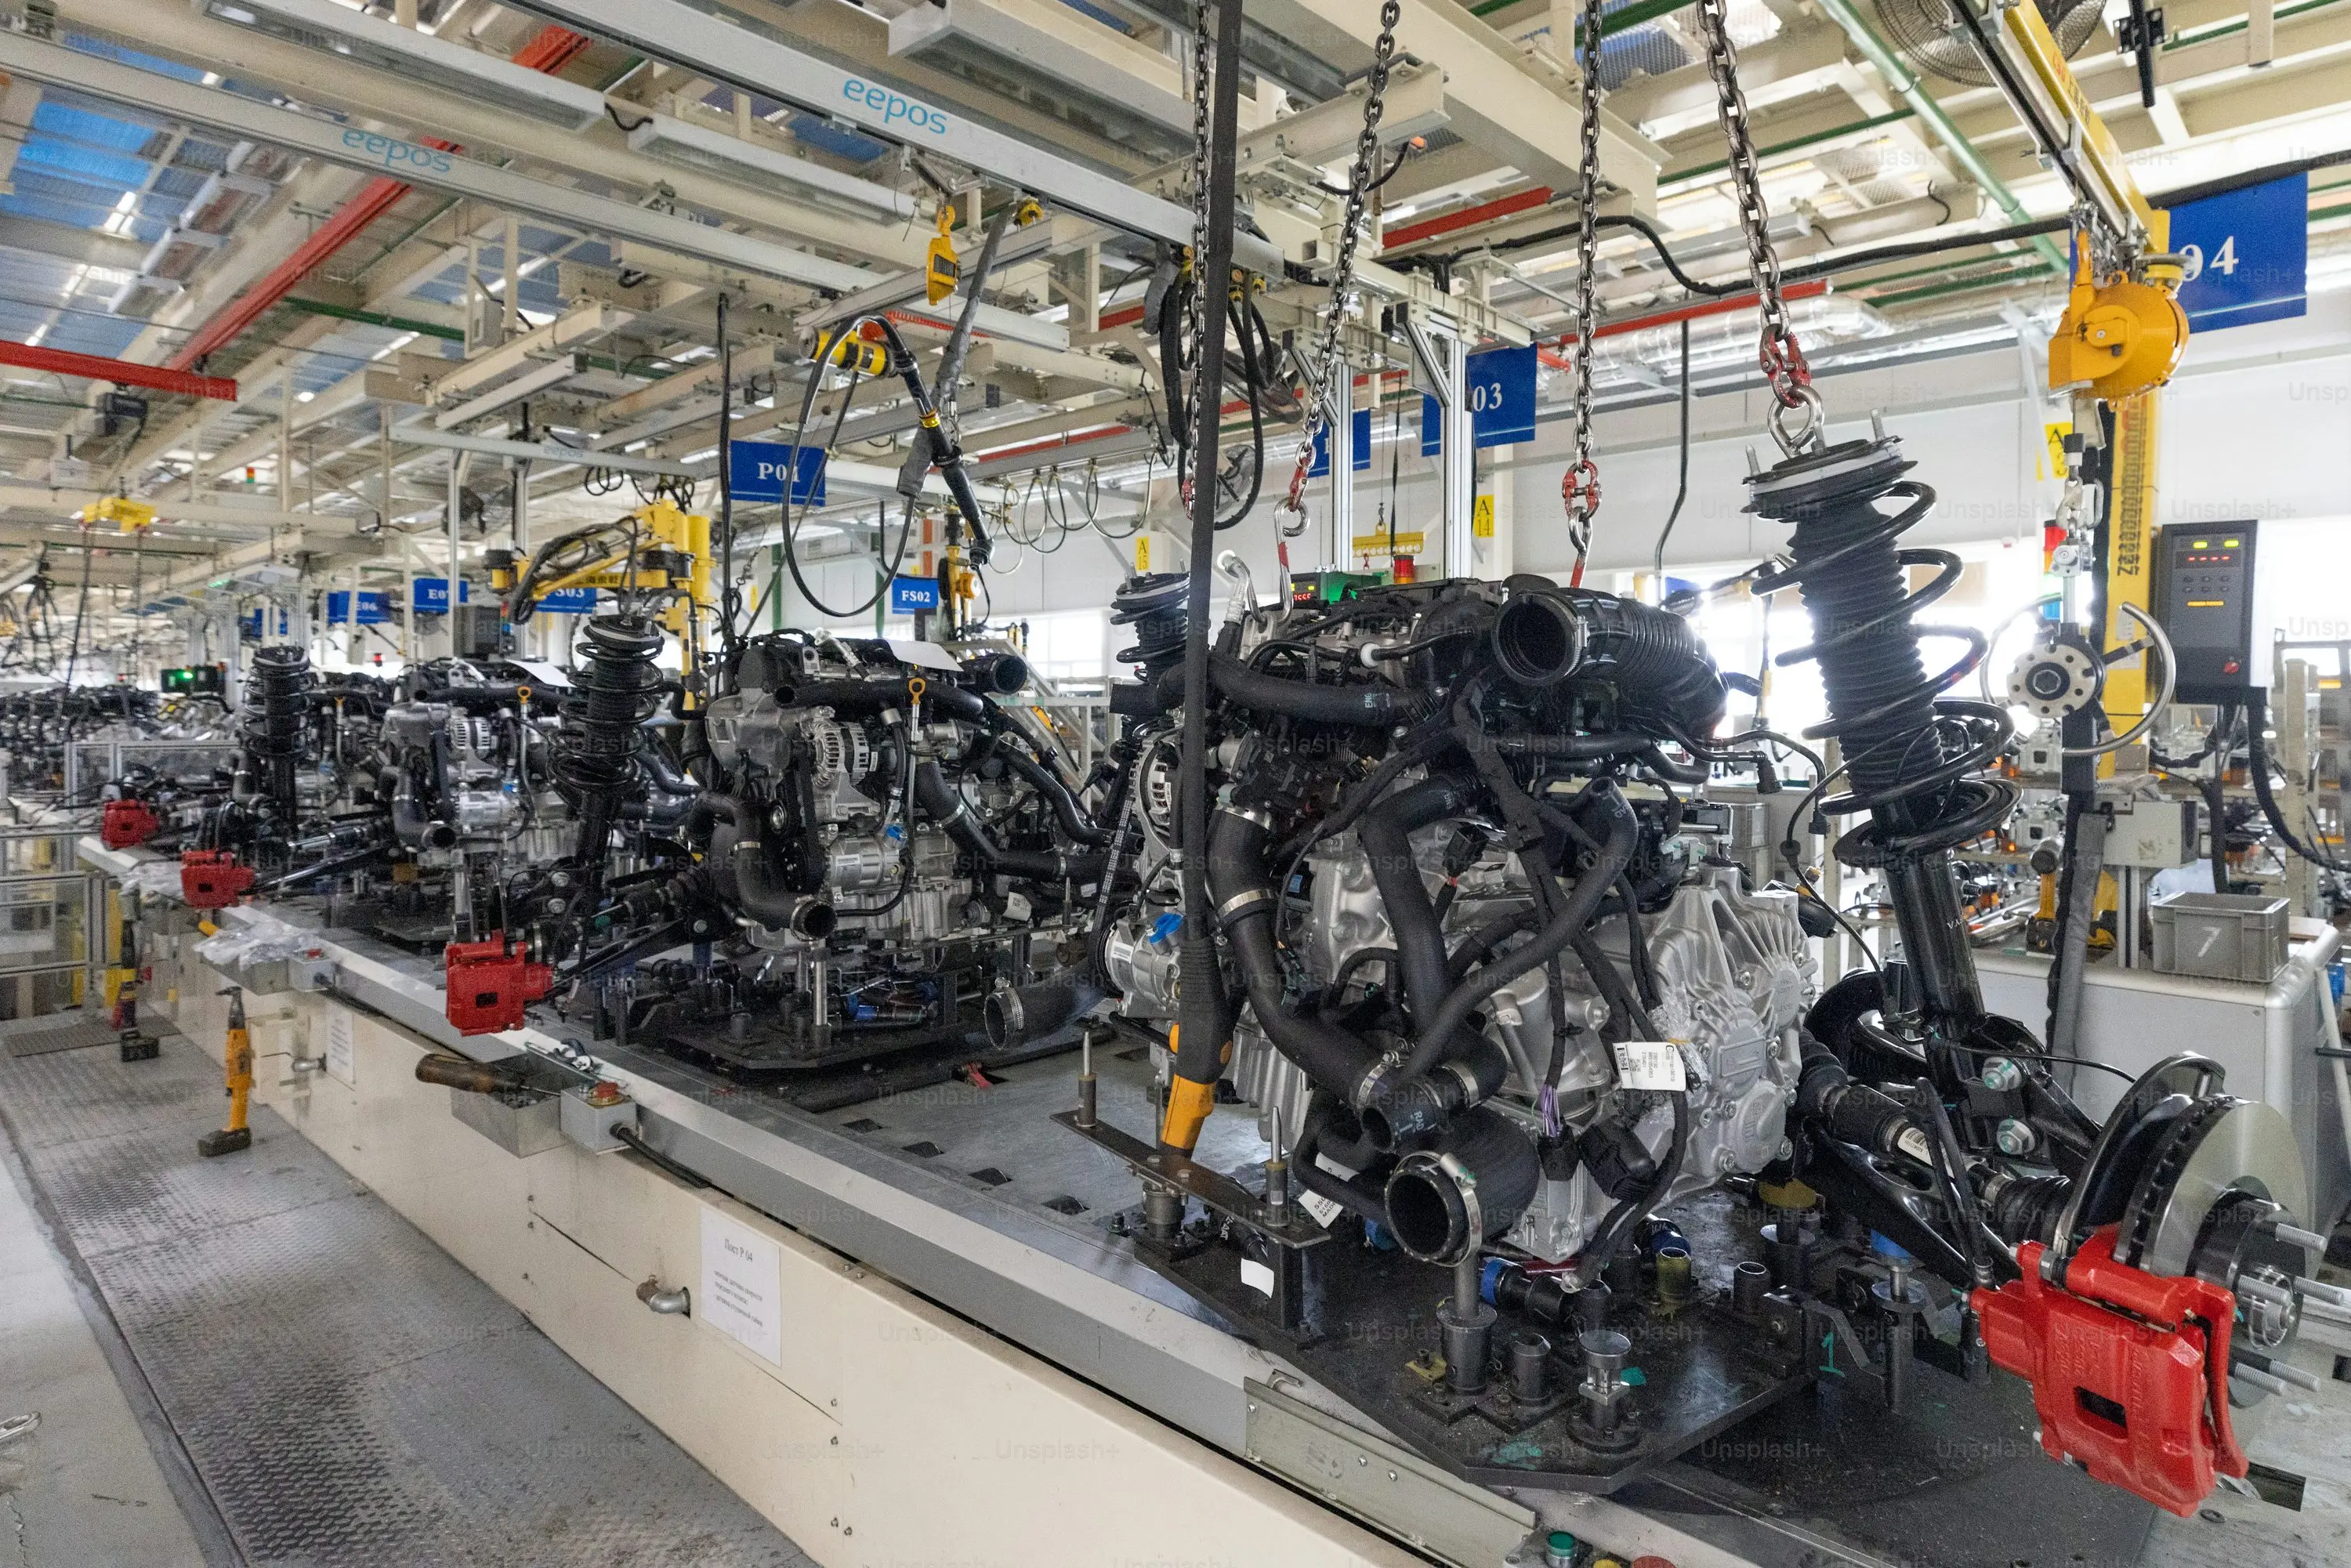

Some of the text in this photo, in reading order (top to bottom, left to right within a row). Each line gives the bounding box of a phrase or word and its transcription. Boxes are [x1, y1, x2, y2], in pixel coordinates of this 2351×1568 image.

[843, 78, 947, 134] eepos
[342, 130, 451, 172] eepos
[1473, 382, 1503, 412] 03
[1477, 498, 1491, 516] A
[1476, 517, 1491, 537] 14
[1138, 539, 1147, 555] A
[428, 588, 449, 600] E0
[901, 590, 931, 603] FS02
[2197, 926, 2222, 958] 7
[724, 1237, 739, 1255] Пост
[745, 1251, 754, 1262] 04
[1818, 1331, 1846, 1378] 1
